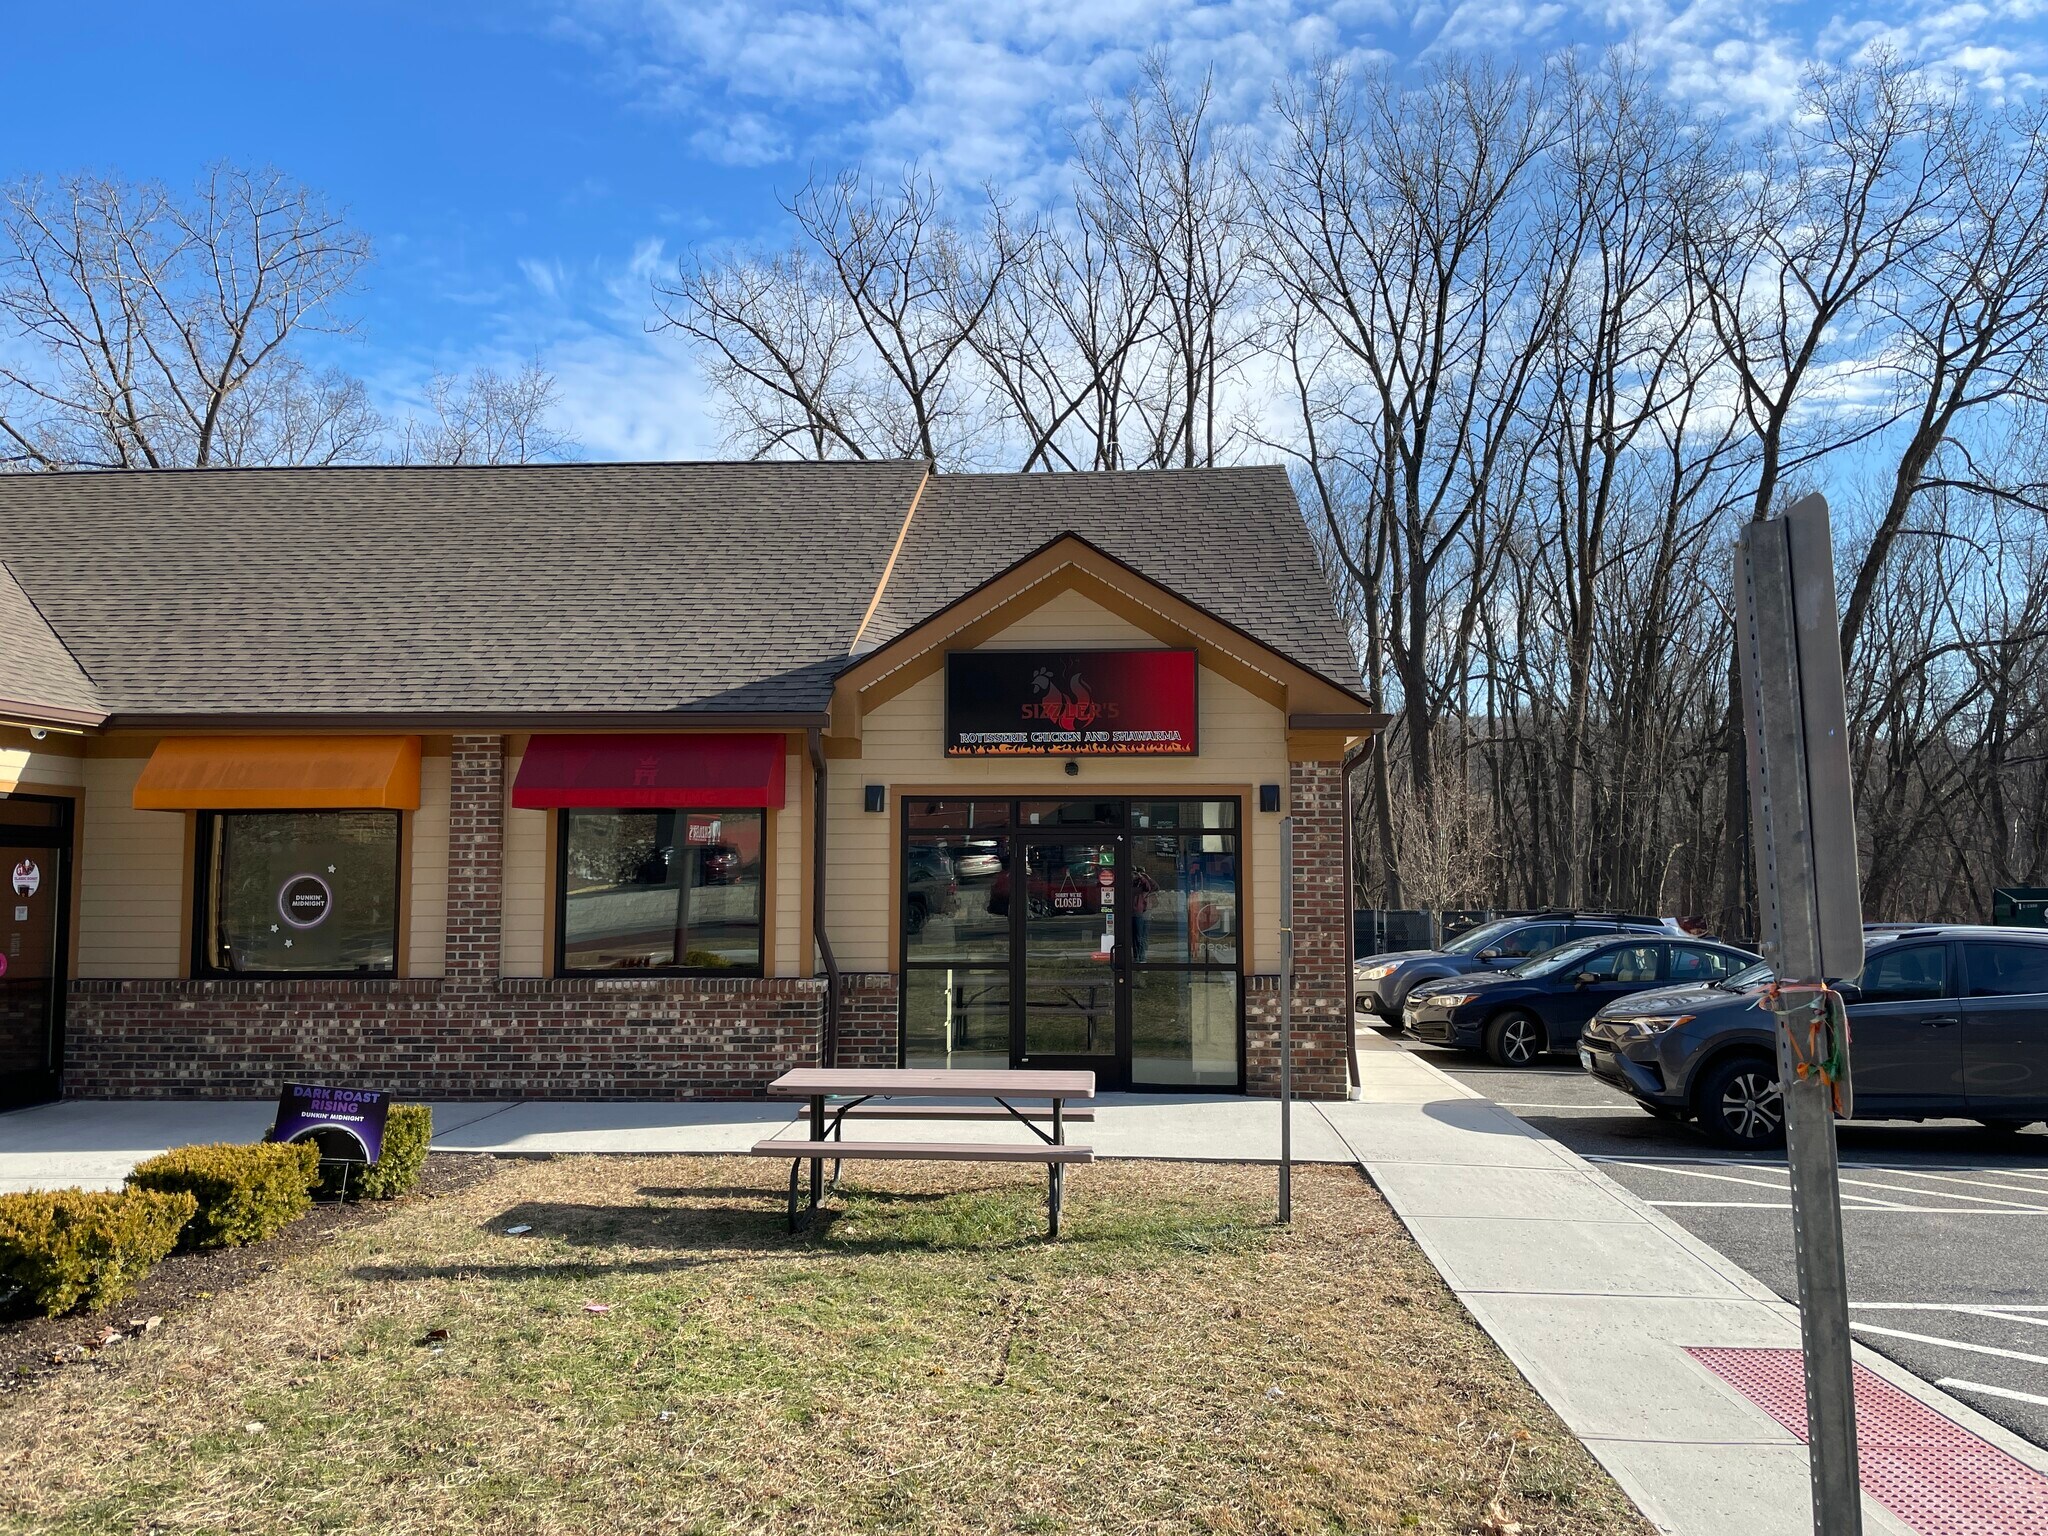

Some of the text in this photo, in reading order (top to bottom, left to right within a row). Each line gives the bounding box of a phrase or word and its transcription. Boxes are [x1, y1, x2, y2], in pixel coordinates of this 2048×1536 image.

[1021, 703, 1120, 719] SIZZLER'S
[959, 730, 1182, 743] ROTISSERIE CHICKEN AND SHAWARMA
[1055, 898, 1082, 908] CLOSED
[293, 1087, 380, 1104] DARK ROAST
[311, 1100, 358, 1112] RISING
[301, 1111, 364, 1122] DUNKIN' MIDNIGHT
